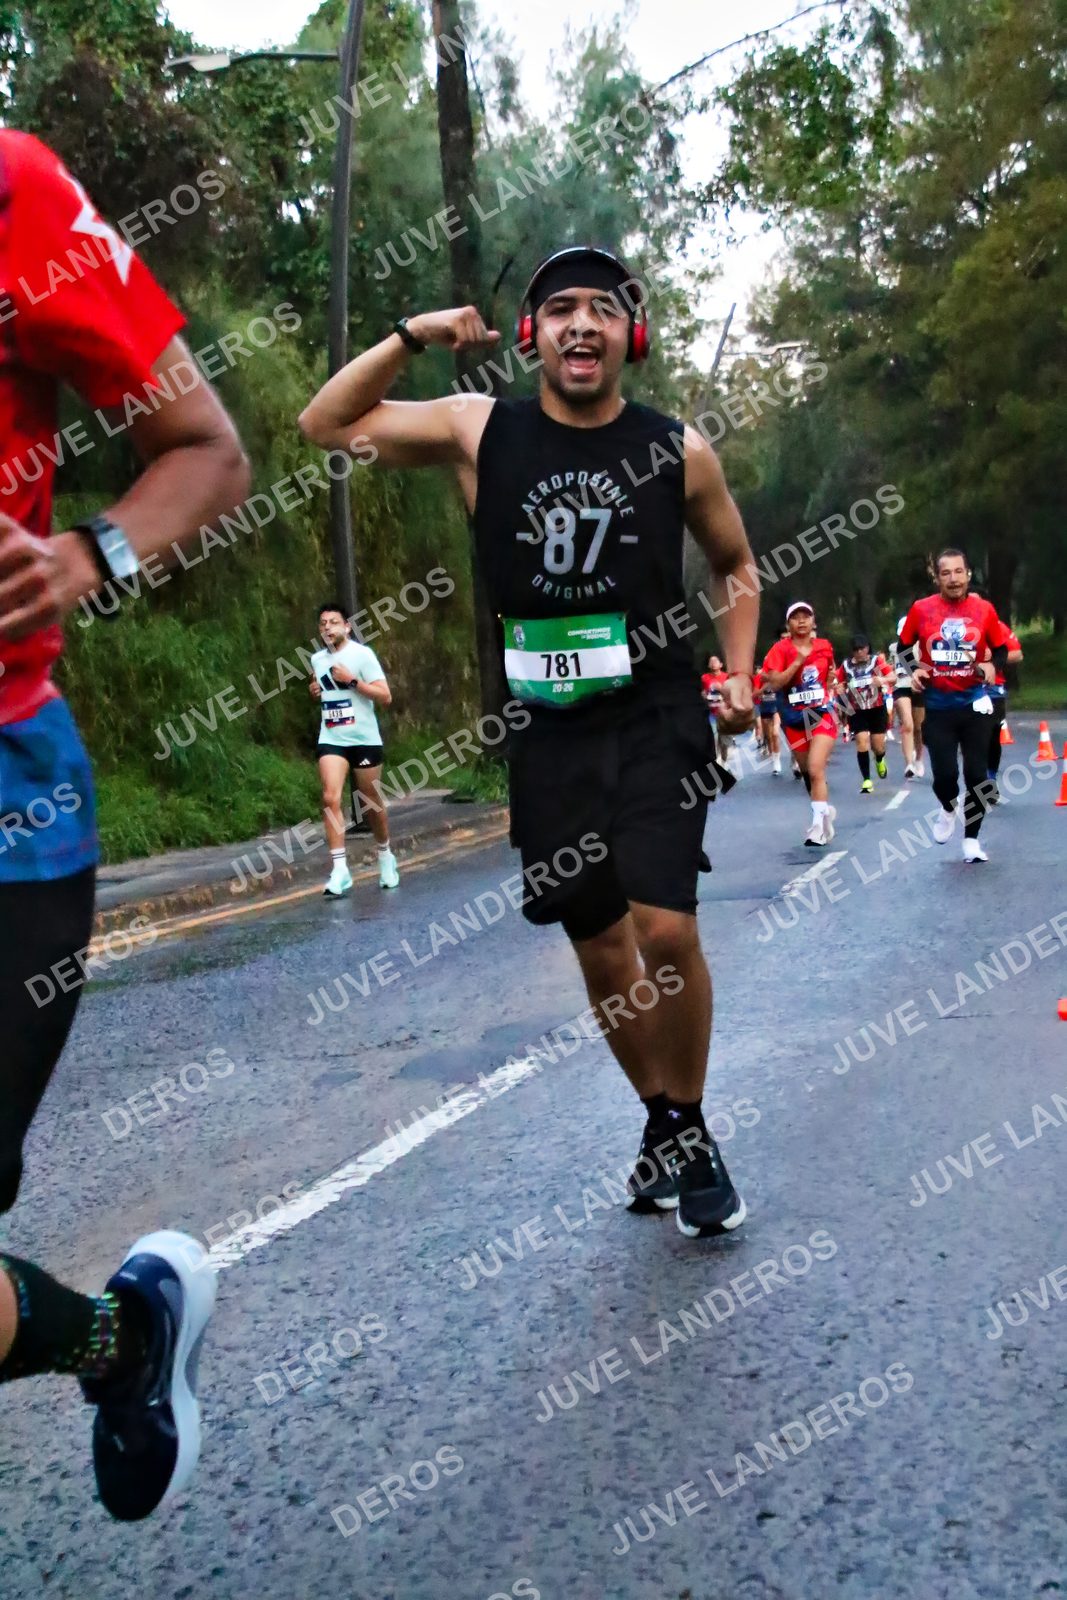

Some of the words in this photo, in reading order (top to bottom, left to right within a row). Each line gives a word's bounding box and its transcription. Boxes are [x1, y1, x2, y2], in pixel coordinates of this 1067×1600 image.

[522, 471, 635, 518] AEROPOSTALE
[544, 507, 612, 575] 87
[532, 574, 617, 600] ORIGINAL
[541, 652, 582, 679] 781
